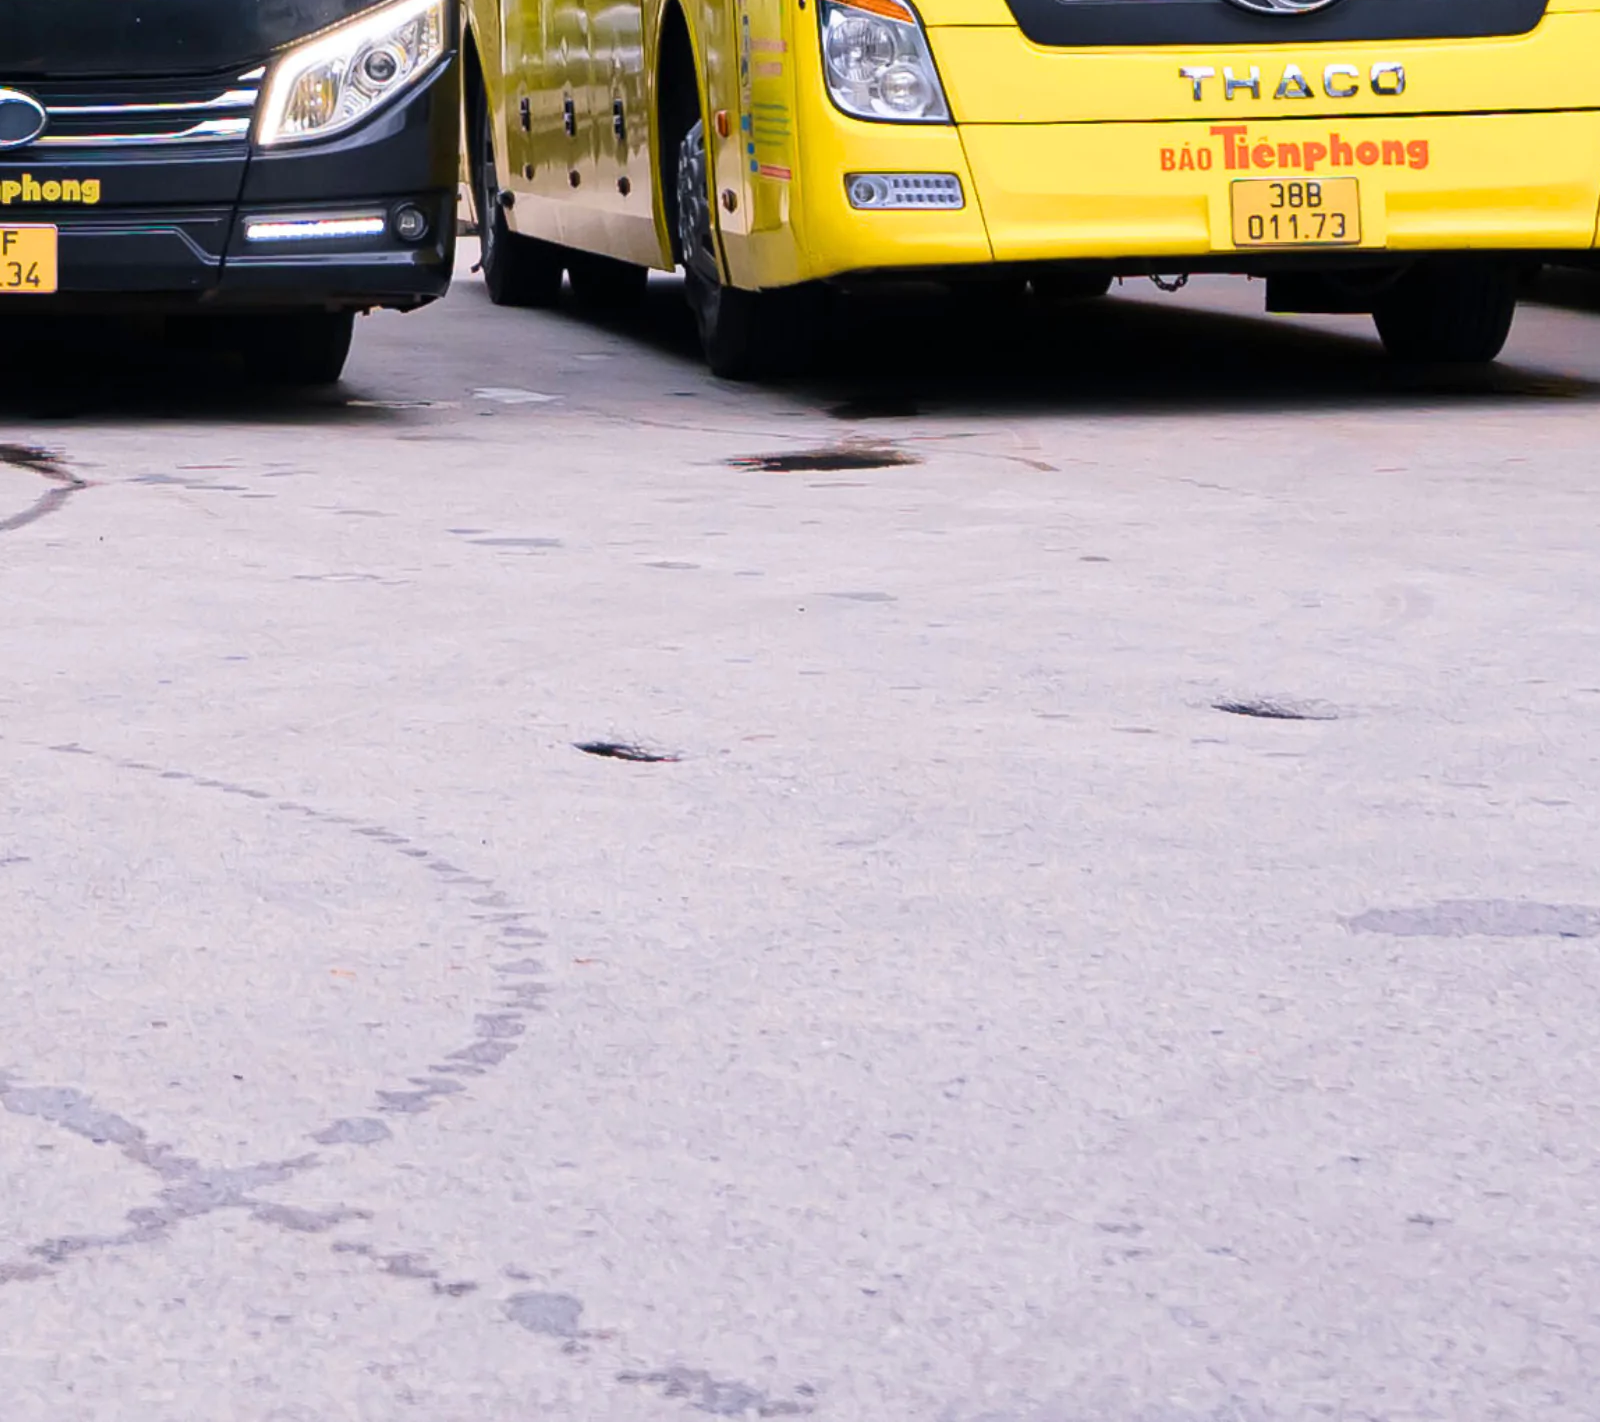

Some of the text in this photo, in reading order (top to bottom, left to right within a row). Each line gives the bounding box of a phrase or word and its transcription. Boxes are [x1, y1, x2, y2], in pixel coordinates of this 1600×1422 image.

[1179, 62, 1407, 101] THACO
[1160, 141, 1212, 171] BÁO
[1269, 182, 1321, 208] 38B
[1248, 213, 1345, 239] 011.73
